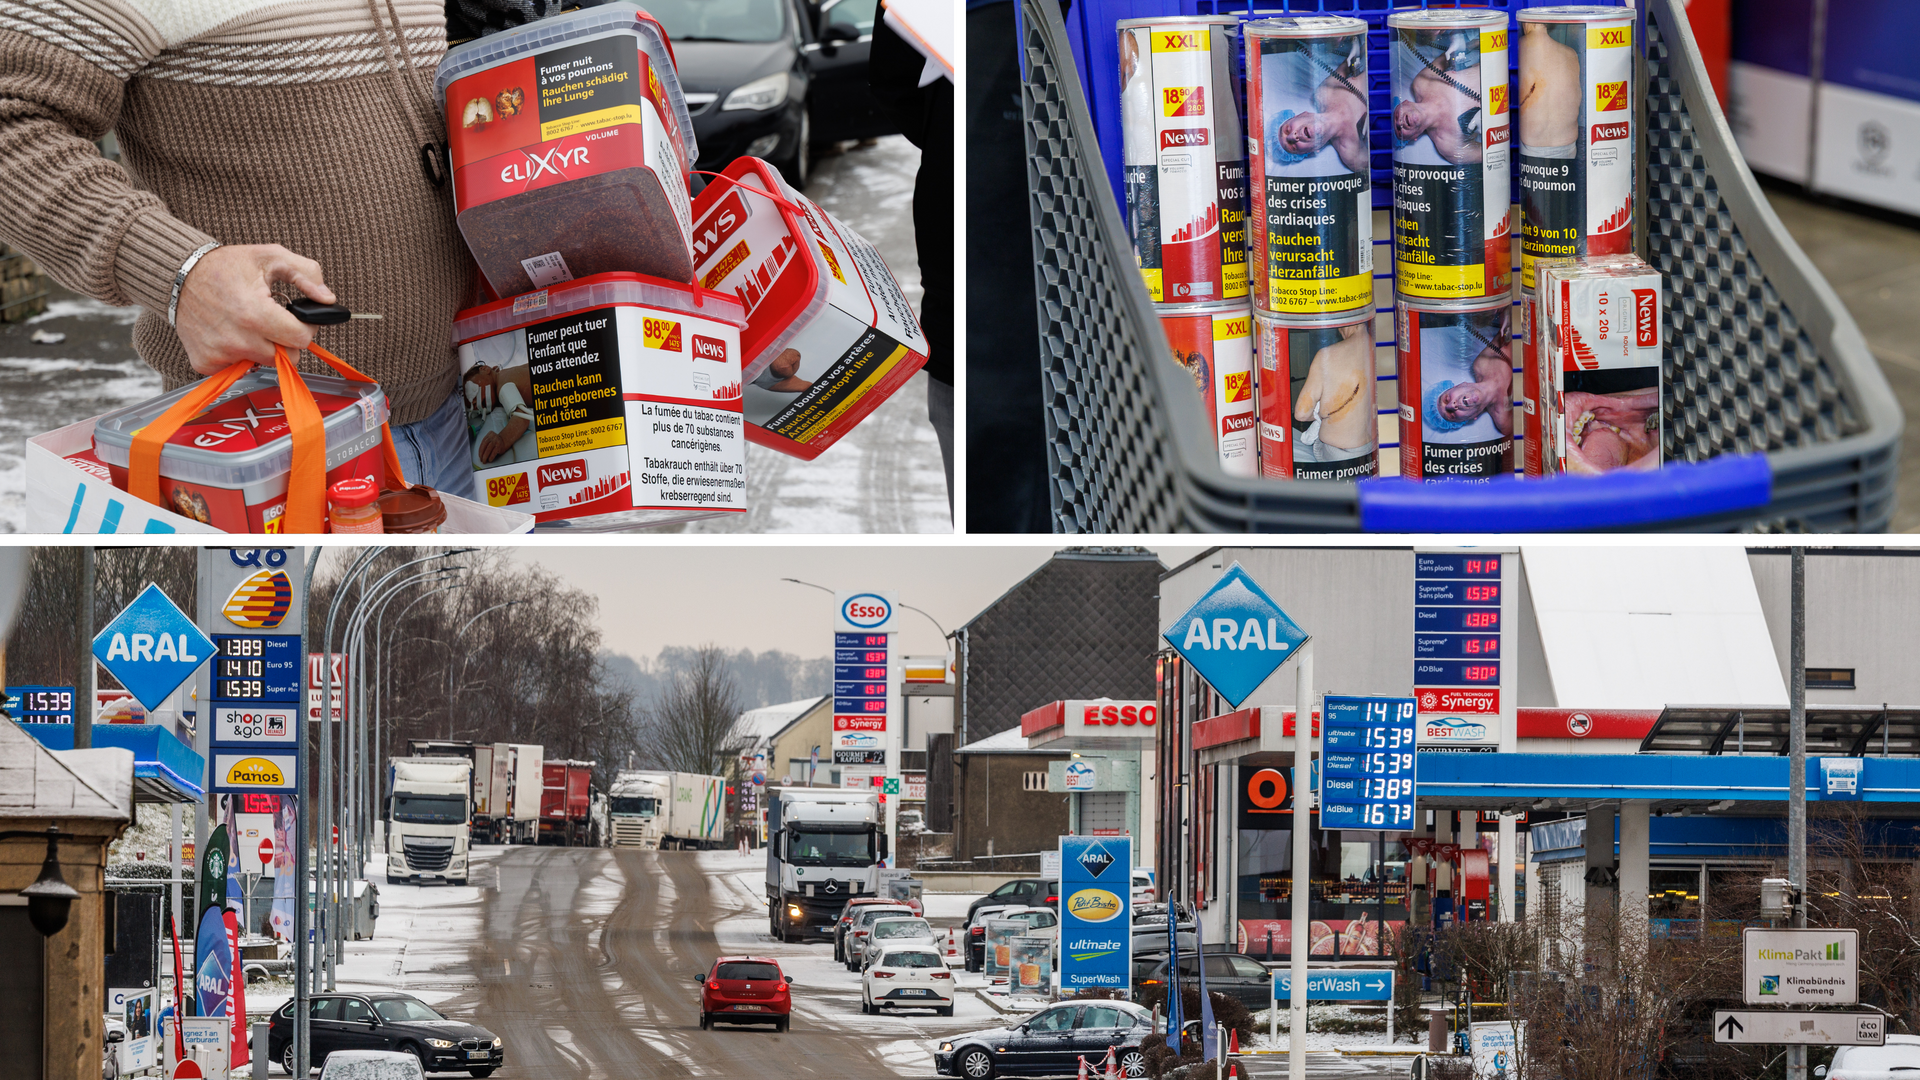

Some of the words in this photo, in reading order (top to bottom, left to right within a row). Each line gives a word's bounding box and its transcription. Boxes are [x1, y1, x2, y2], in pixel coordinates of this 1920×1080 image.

[1164, 34, 1198, 49] XXL
[1491, 34, 1508, 49] XXL
[1600, 31, 1625, 45] XXL
[540, 62, 571, 76] Fumer
[572, 56, 593, 68] nuit
[541, 76, 547, 85] à
[549, 73, 566, 83] vos
[568, 62, 613, 80] poumons
[542, 82, 584, 97] Rauchen
[585, 71, 629, 87] schädigt
[543, 97, 562, 108] Ihre
[564, 89, 595, 102] Lunge
[585, 129, 619, 141] VOLUME
[1165, 132, 1205, 144] News
[1595, 126, 1627, 139] News
[500, 146, 590, 183] ELIXYR
[1521, 164, 1559, 178] provoque
[1561, 165, 1569, 177] 9
[1408, 168, 1465, 183] provoque
[1267, 178, 1305, 193] Fumer
[1308, 177, 1362, 195] provoque
[1522, 176, 1531, 188] du
[1532, 180, 1576, 192] poumon
[1220, 187, 1239, 200] vos
[1268, 195, 1288, 209] des
[1290, 196, 1327, 209] crises
[1268, 212, 1336, 229] cardiaques
[1269, 231, 1321, 246] Rauchen
[1533, 227, 1539, 237] 9
[1540, 228, 1559, 239] von
[1563, 228, 1577, 239] 10
[1223, 247, 1243, 263] Ihre
[1269, 248, 1335, 262] verursacht
[1270, 264, 1340, 279] Herzanfälle
[1271, 286, 1298, 296] Tobacco
[1299, 287, 1317, 297] Stop
[1319, 286, 1338, 296] Line:
[1414, 281, 1483, 292] www.tabac-stop.lu
[1271, 296, 1287, 305] 8002
[1288, 296, 1308, 305] 6767
[1599, 291, 1608, 305] 10
[1640, 294, 1653, 342] News
[528, 328, 558, 345] Fumer
[560, 322, 583, 341] peut
[585, 317, 608, 329] tuer
[1225, 320, 1247, 336] XXL
[568, 338, 587, 354] que
[695, 338, 725, 359] News
[531, 361, 554, 376] vous
[555, 351, 600, 370] attendez
[533, 378, 575, 396] Rauchen
[576, 373, 602, 388] kann
[767, 407, 797, 430] Fumer
[794, 379, 829, 408] bouche
[827, 364, 845, 380] vos
[843, 332, 876, 365] artères
[534, 397, 548, 411] Ihr
[550, 385, 617, 409] ungeborenes
[777, 405, 818, 435] Rauchen
[815, 367, 858, 405] verstopft
[853, 350, 875, 370] Ihre
[536, 410, 559, 427] Kind
[560, 407, 588, 421] töten
[641, 404, 653, 416] La
[654, 405, 681, 419] fumée
[682, 408, 693, 420] du
[694, 410, 714, 422] tabac
[715, 412, 741, 425] contient
[652, 421, 672, 434] plus
[673, 422, 684, 434] de
[685, 423, 695, 435] 70
[696, 425, 735, 439] substances
[788, 410, 826, 439] Arterien
[1226, 416, 1252, 430] News
[538, 434, 561, 444] Tobacco
[590, 425, 606, 435] 8002
[606, 422, 623, 432] 6767
[337, 434, 376, 462] TOBACCO
[539, 438, 594, 453] www.tabac-stop.lu
[671, 437, 723, 453] cancérigènes.
[1424, 445, 1463, 458] Fumer
[1466, 440, 1511, 460] provoque
[643, 457, 692, 471] Tabakrauch
[694, 460, 719, 473] enthält
[720, 461, 734, 474] über
[735, 463, 743, 474] 70
[1296, 468, 1334, 480] Fumer
[1336, 459, 1376, 481] provoque
[1425, 460, 1445, 473] des
[1448, 462, 1483, 474] crises
[541, 466, 582, 483] News
[641, 472, 670, 487] Stoffe,
[672, 474, 685, 486] die
[686, 475, 746, 489] erwiesenermaßen
[660, 489, 716, 504] krebserregend
[717, 491, 733, 503] sind.
[1434, 592, 1454, 600] plomb
[850, 602, 885, 618] Esso
[1182, 617, 1290, 651] ARAL
[106, 632, 198, 662] ARAL
[1328, 703, 1359, 711] EuroSuper
[1441, 695, 1494, 710] Synergy
[226, 710, 263, 726] shop
[1084, 705, 1157, 726] ESSO
[233, 725, 263, 739] &go
[850, 719, 883, 730] Synergy
[1327, 729, 1356, 737] ultimate
[1427, 728, 1486, 737] BESTWASH
[233, 770, 279, 783] Panos
[1326, 780, 1354, 789] Diesel
[1326, 805, 1354, 813] AdBlue
[1082, 853, 1110, 864] ARAL
[1069, 939, 1121, 950] ultimate
[199, 974, 226, 996] ARAL
[1070, 974, 1121, 984] SuperWash
[1786, 976, 1846, 986] Klimabündnis
[1797, 987, 1835, 996] Gemeng
[1860, 1020, 1877, 1030] éco
[1858, 1030, 1879, 1039] taxe
